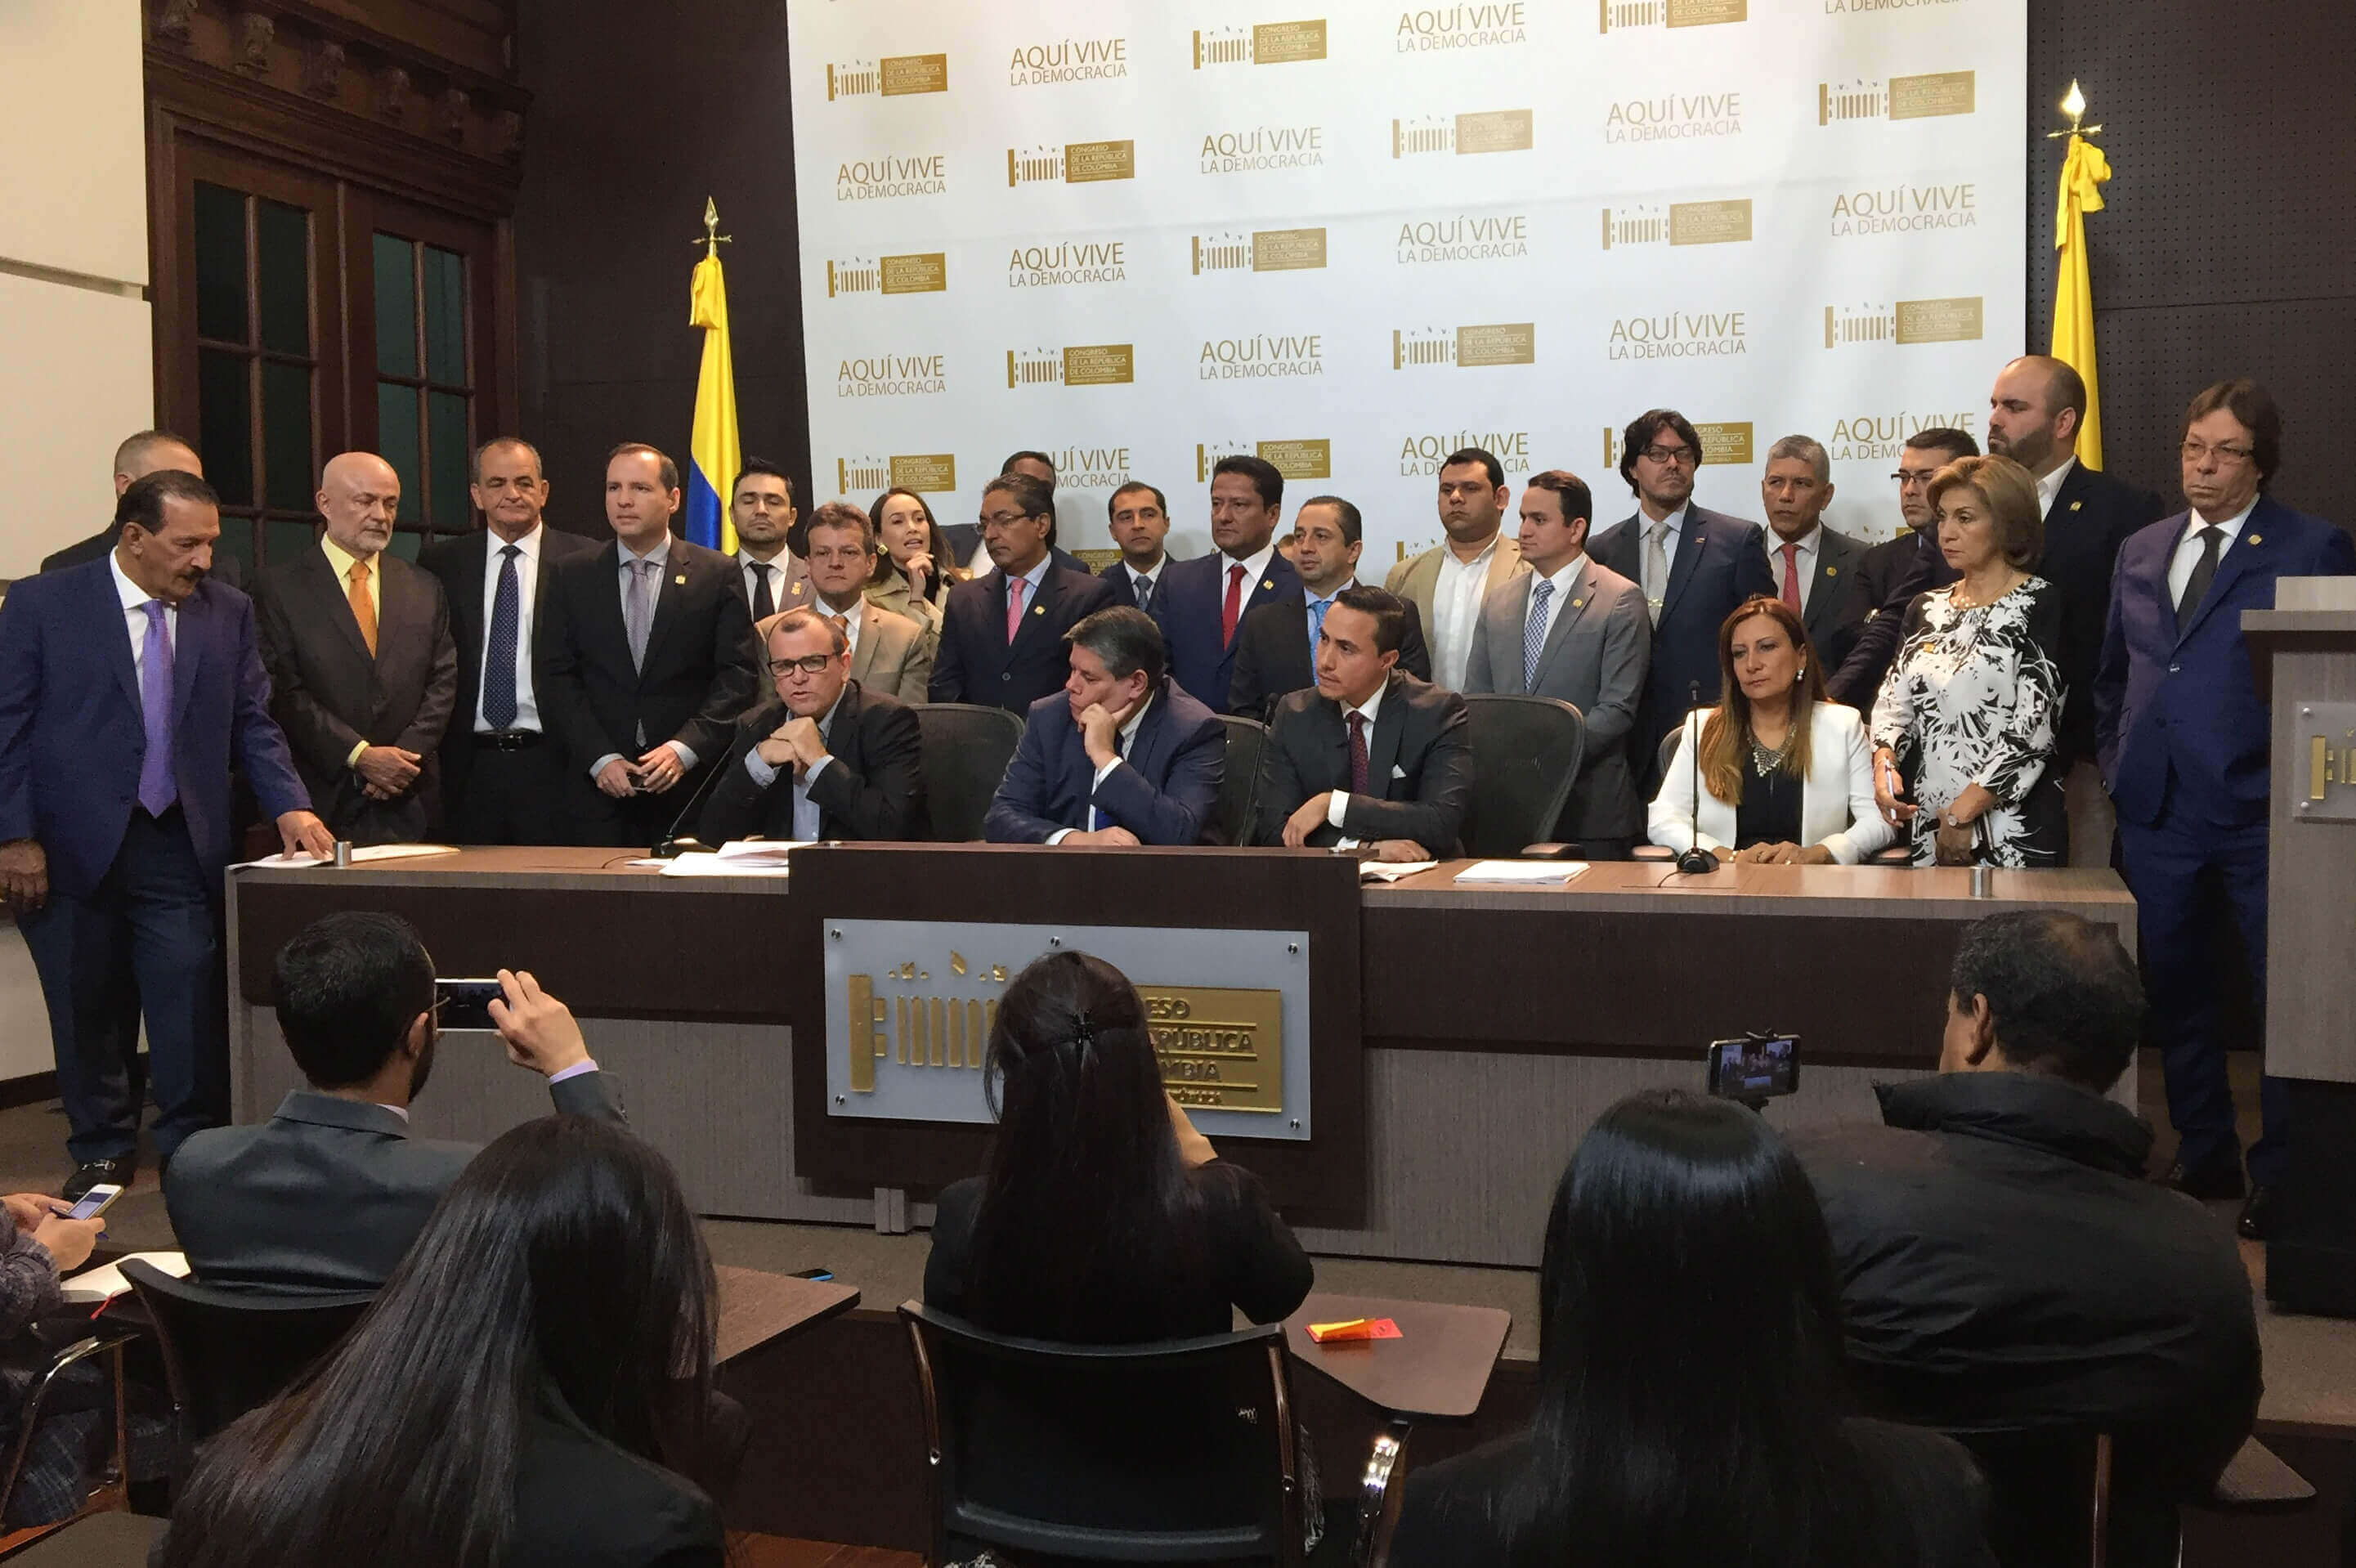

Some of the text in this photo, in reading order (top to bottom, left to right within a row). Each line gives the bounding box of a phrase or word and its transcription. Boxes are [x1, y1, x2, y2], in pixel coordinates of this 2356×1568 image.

[1397, 2, 1525, 37] AQUÍ VIVE
[1397, 29, 1526, 53] LA DEMOCRACIA
[1010, 39, 1126, 71] AQUÍ VIVE
[1010, 64, 1127, 86] LA DEMOCRACIA
[1606, 93, 1740, 128] AQUÍ VIVE
[1202, 127, 1322, 159] AQUÍ VIVE
[1606, 119, 1742, 144] LA DEMOCRACIA
[837, 155, 946, 186] AQUÍ VIVE
[1202, 152, 1324, 174] LA DEMOCRACIA
[838, 180, 947, 200] LA DEMOCRACIA
[1831, 184, 1976, 219] AQUÍ VIVE
[1398, 214, 1527, 249] AQUÍ VIVE
[1831, 212, 1976, 236] LA DEMOCRACIA
[1010, 242, 1125, 272] AQUÍ VIVE
[1398, 242, 1528, 264] LA DEMOCRACIA
[1010, 267, 1126, 288] LA DEMOCRACIA
[1610, 311, 1747, 344] AQUÍ VIVE
[1200, 334, 1322, 365] AQUÍ VIVE
[1610, 339, 1747, 360] LA DEMOCRACIA
[839, 354, 945, 383] AQUÍ VIVE
[1200, 361, 1324, 380] LA DEMOCRACIA
[839, 379, 947, 397] LA DEMOCRACIA
[1831, 410, 1906, 444] AQUÍ
[1472, 432, 1529, 455] VIVE
[1831, 446, 1852, 460] LA
[1052, 446, 1130, 472] UÍ VIVE
[1401, 462, 1419, 477] LA
[1057, 473, 1131, 488] MOCRACIA
